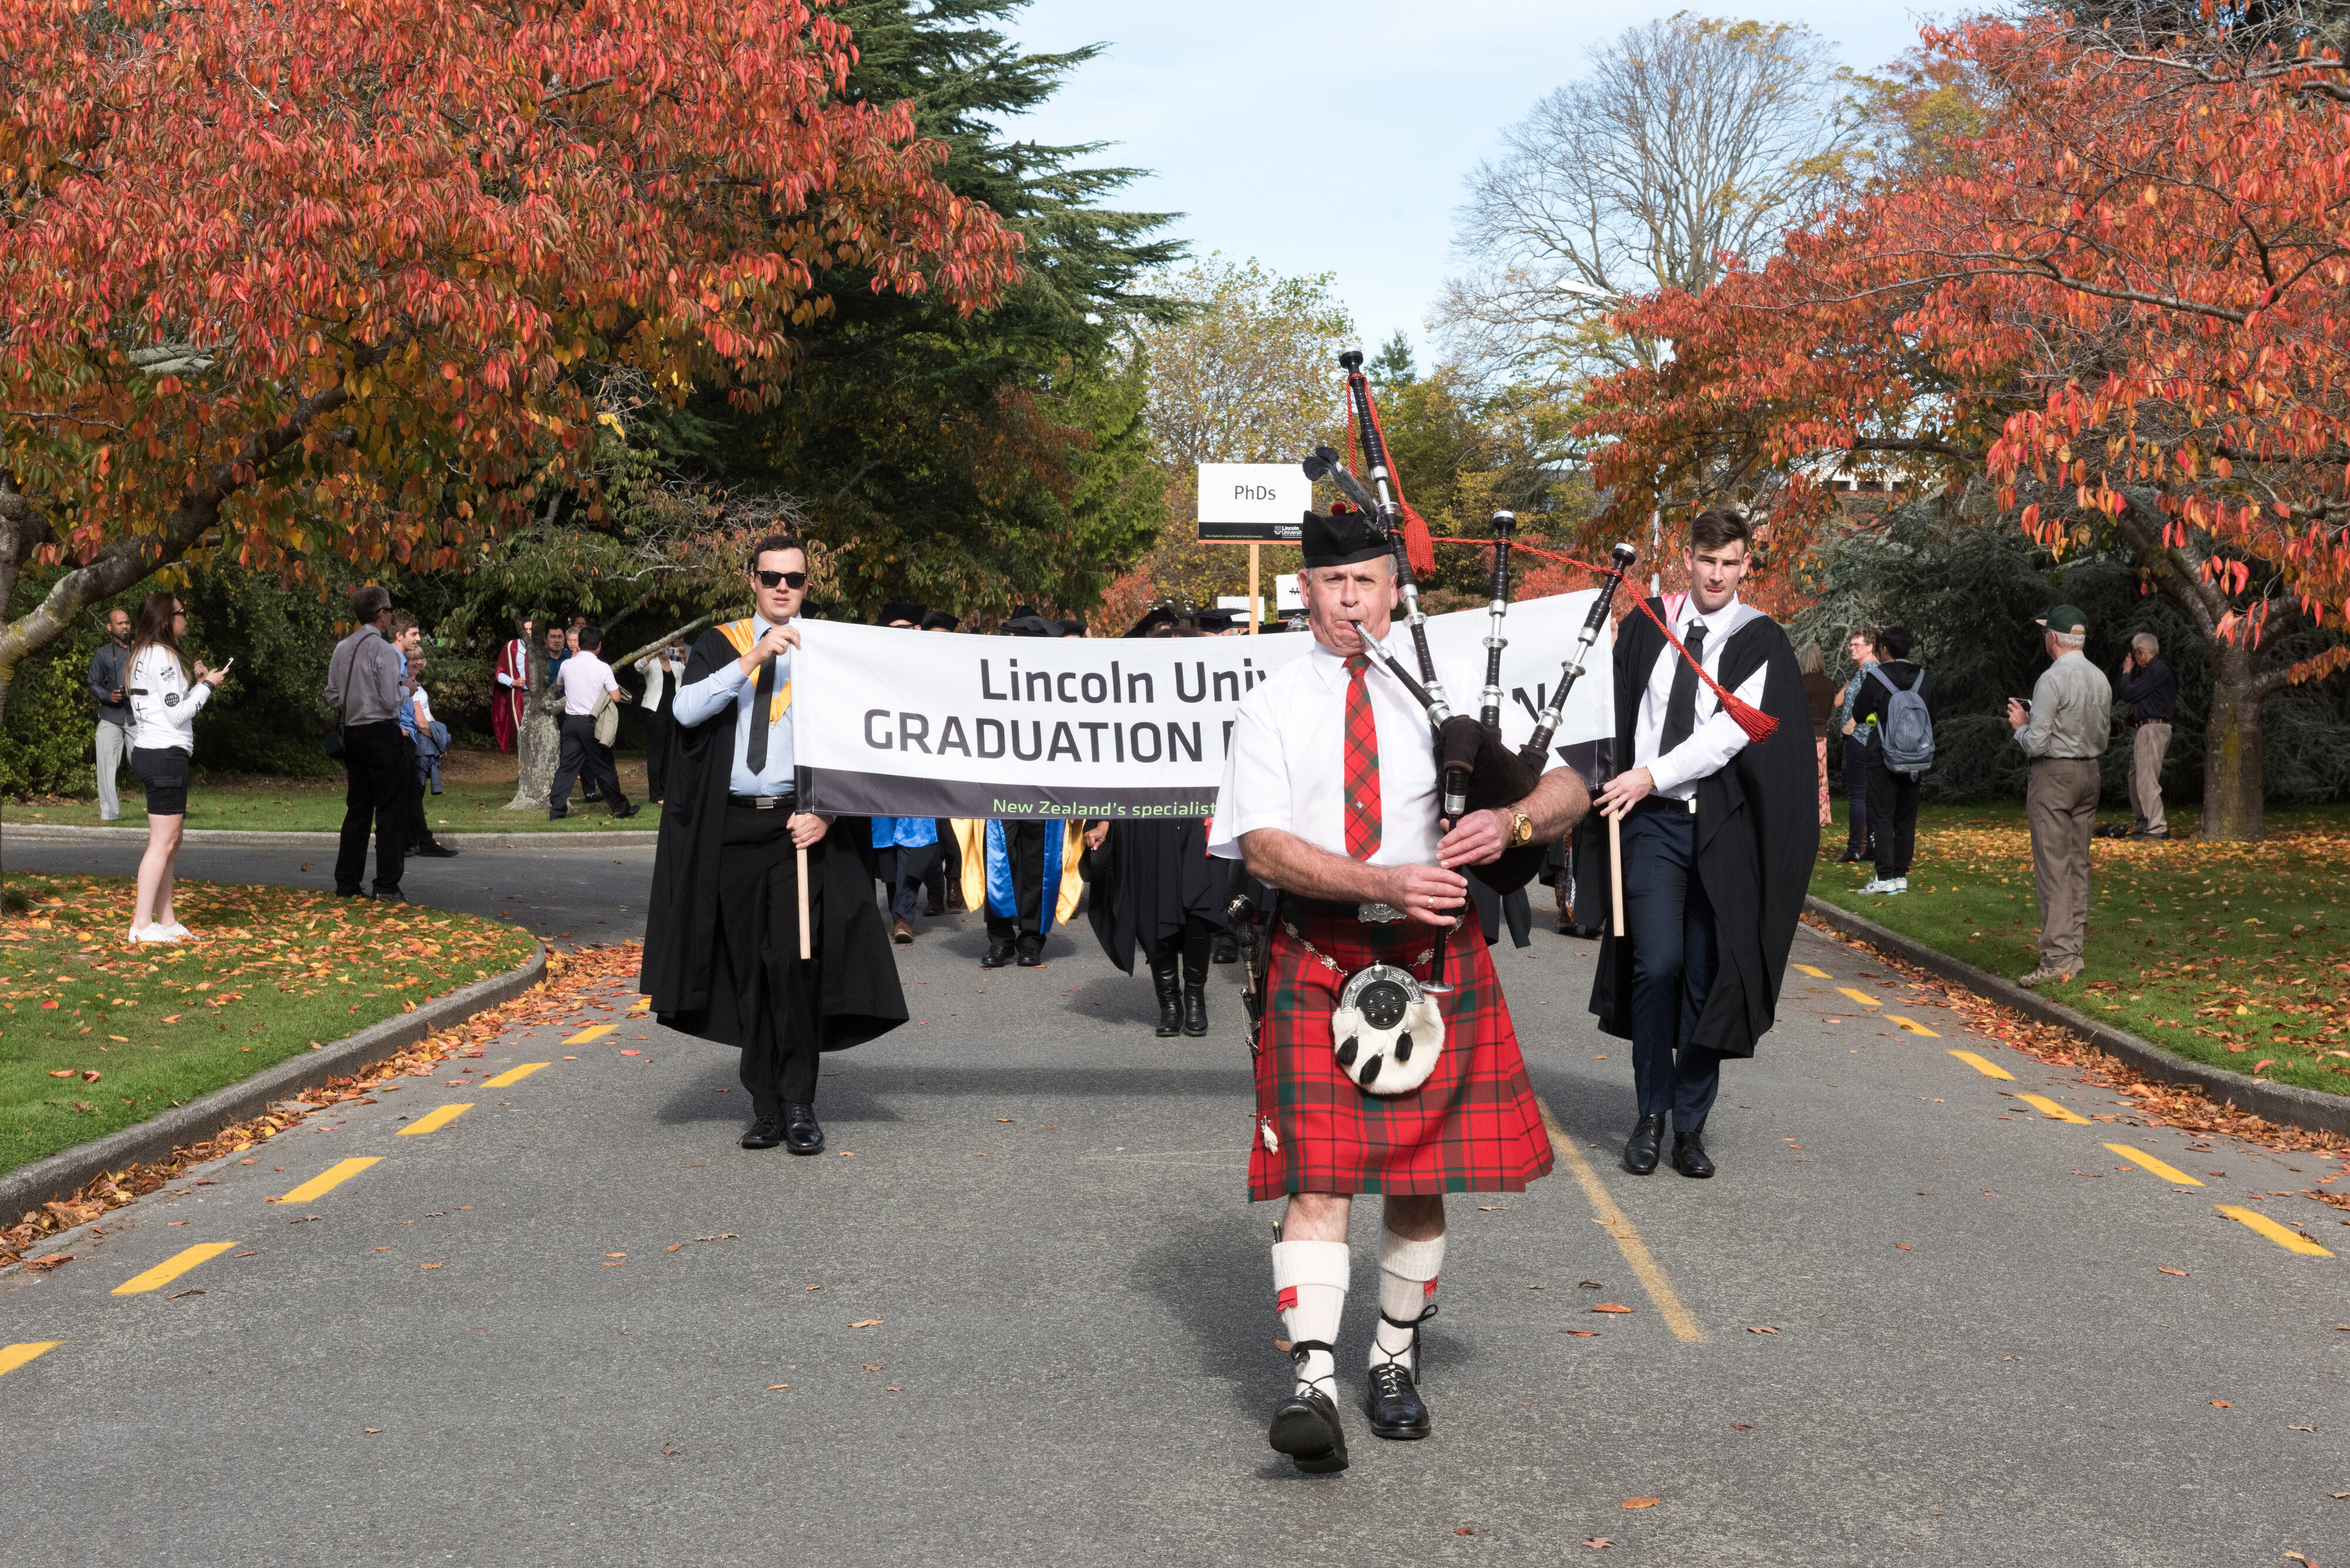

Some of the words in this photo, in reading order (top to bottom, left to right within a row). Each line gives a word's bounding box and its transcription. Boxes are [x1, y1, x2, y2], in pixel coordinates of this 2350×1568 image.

[1235, 485, 1276, 500] PhDs
[980, 659, 1154, 704] Lincoln
[1174, 658, 1266, 703] Uni
[864, 709, 1202, 763] GRADUATION
[993, 798, 1034, 814] New
[1039, 801, 1126, 815] Zealand's
[1132, 801, 1216, 818] specialist
